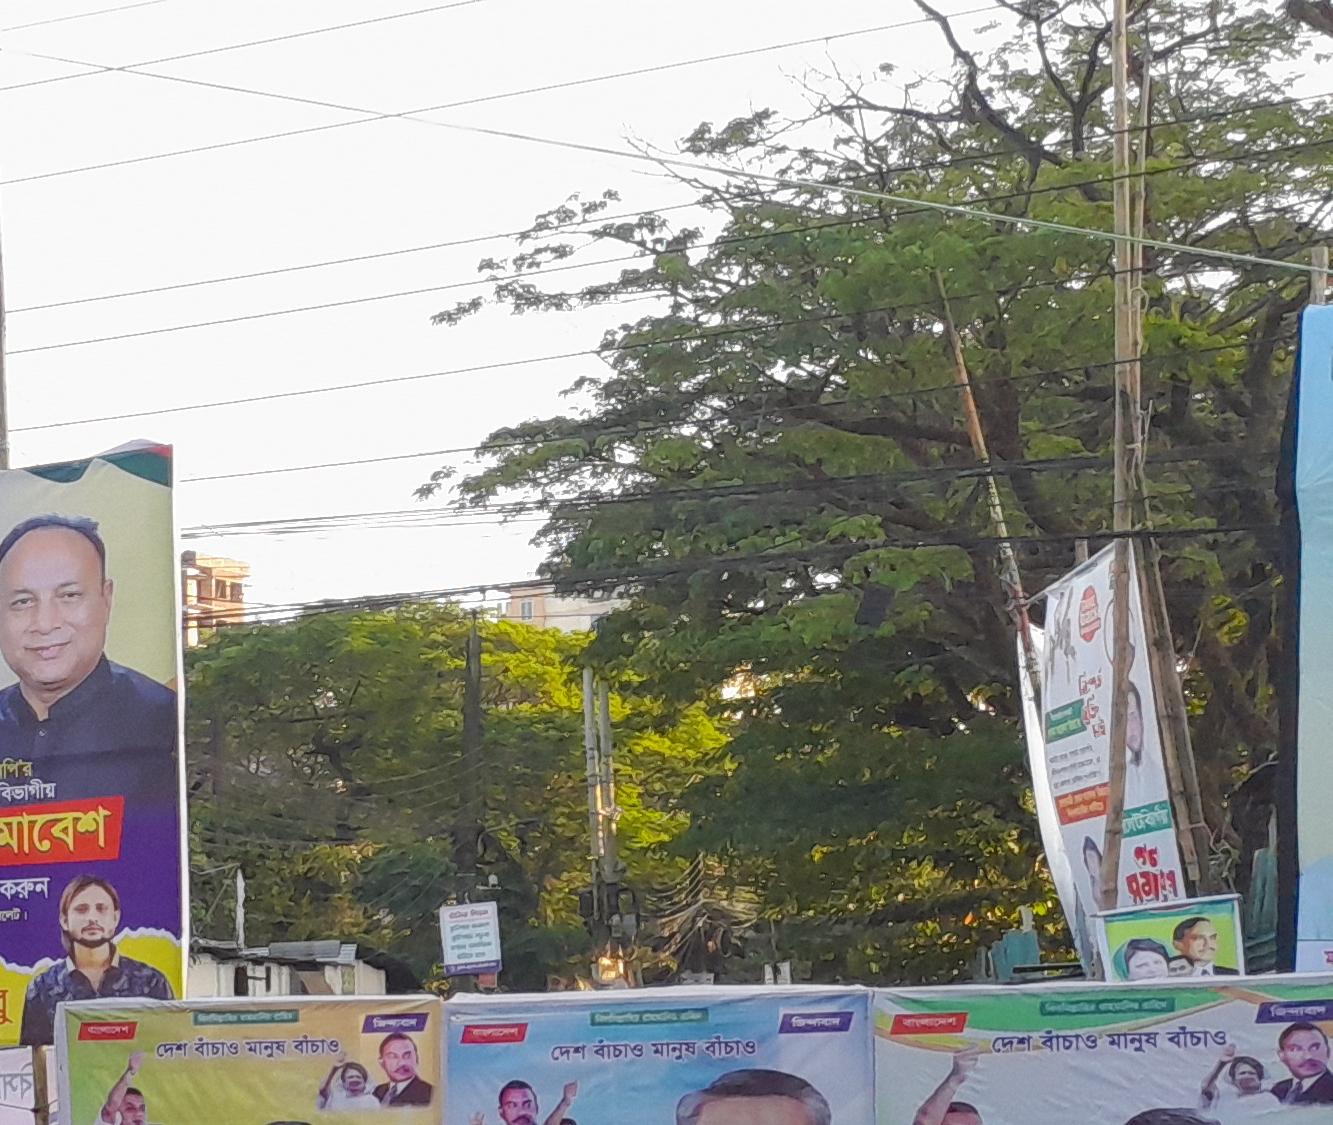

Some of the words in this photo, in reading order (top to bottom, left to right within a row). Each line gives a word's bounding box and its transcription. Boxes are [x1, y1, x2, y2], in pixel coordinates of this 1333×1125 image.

[0, 877, 51, 900] করুন
[157, 1042, 187, 1059] দেশ
[194, 1037, 239, 1056] বাঁচাও
[245, 1040, 286, 1059] মানুষ
[294, 1034, 340, 1056] বাঁচাও
[550, 1046, 585, 1060] দেশ
[593, 1039, 644, 1058] বাঁচাও
[652, 1041, 697, 1061] মানুষ
[705, 1035, 756, 1056] বাঁচাও
[991, 1035, 1032, 1053] দেশ
[1041, 1028, 1098, 1050] বাঁচাও
[1108, 1031, 1159, 1054] মানুষ
[1167, 1025, 1227, 1047] বাঁচাও
